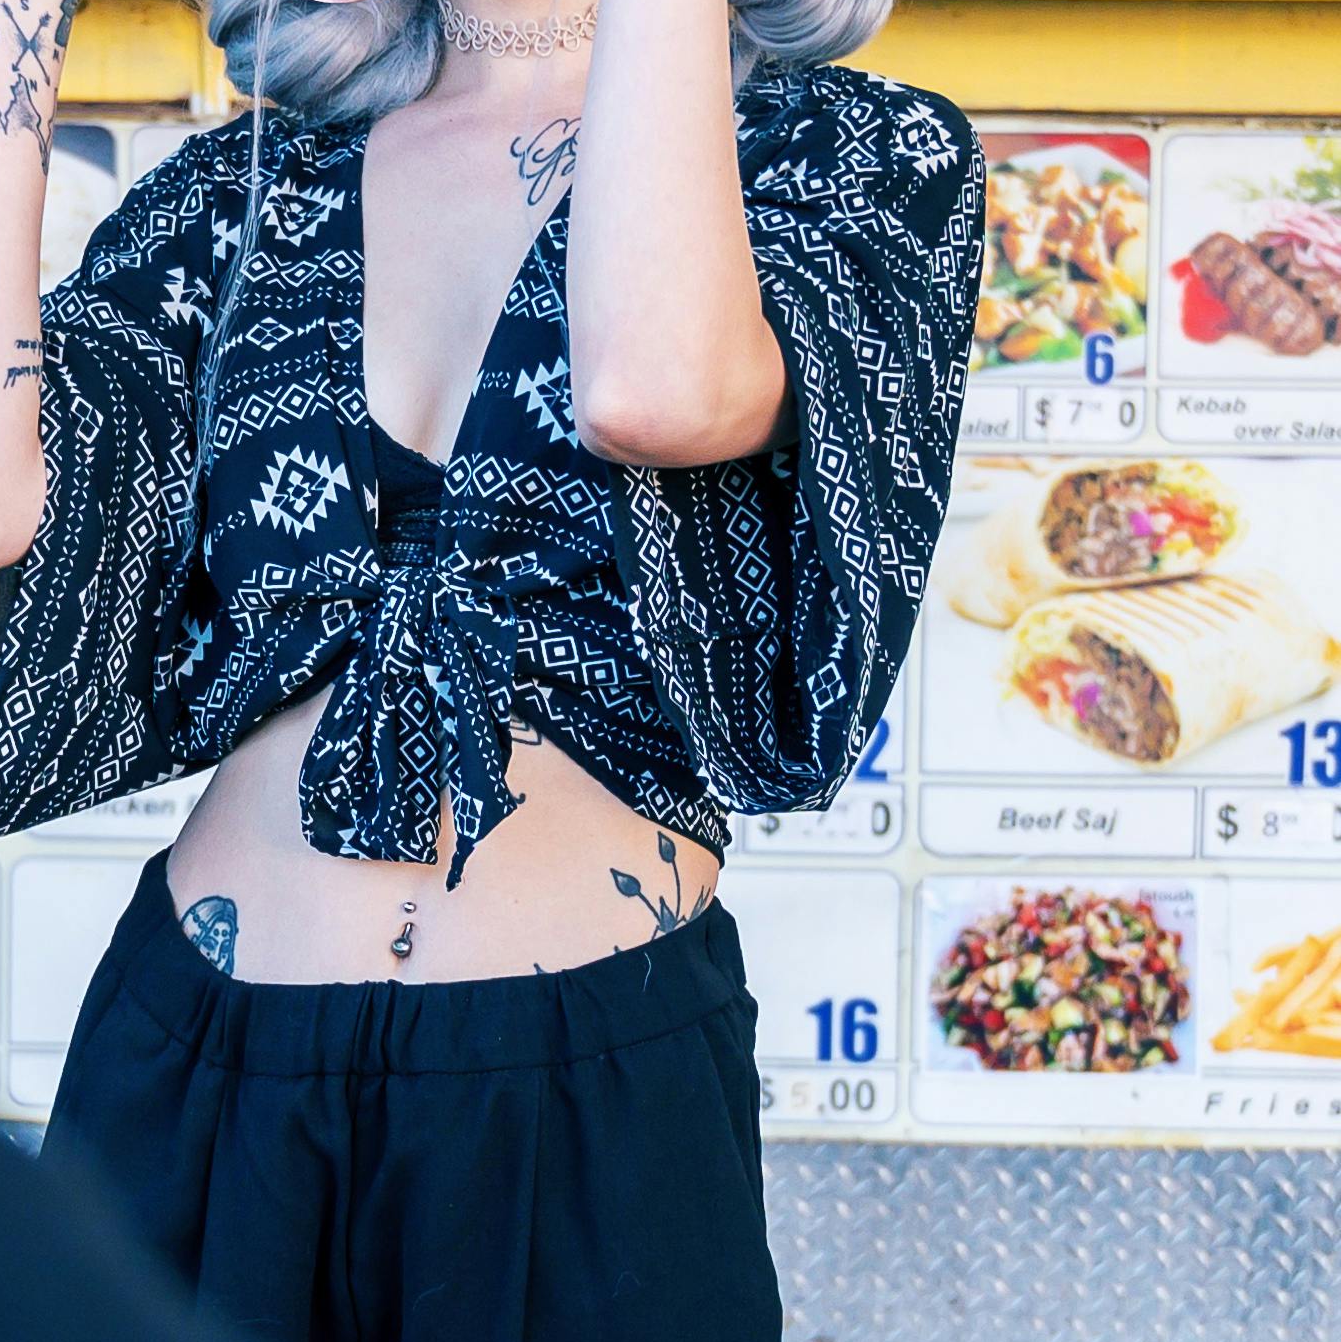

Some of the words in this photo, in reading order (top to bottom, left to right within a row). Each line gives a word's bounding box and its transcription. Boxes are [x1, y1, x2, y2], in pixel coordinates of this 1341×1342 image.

[1084, 333, 1116, 386] 6
[1176, 397, 1247, 415] Kebab
[960, 419, 1010, 438] alad
[1234, 425, 1284, 441] over
[1280, 719, 1341, 788] 13
[998, 808, 1065, 831] Beef
[1072, 808, 1118, 836] Saj
[1217, 803, 1239, 843] $
[805, 997, 878, 1063] 16
